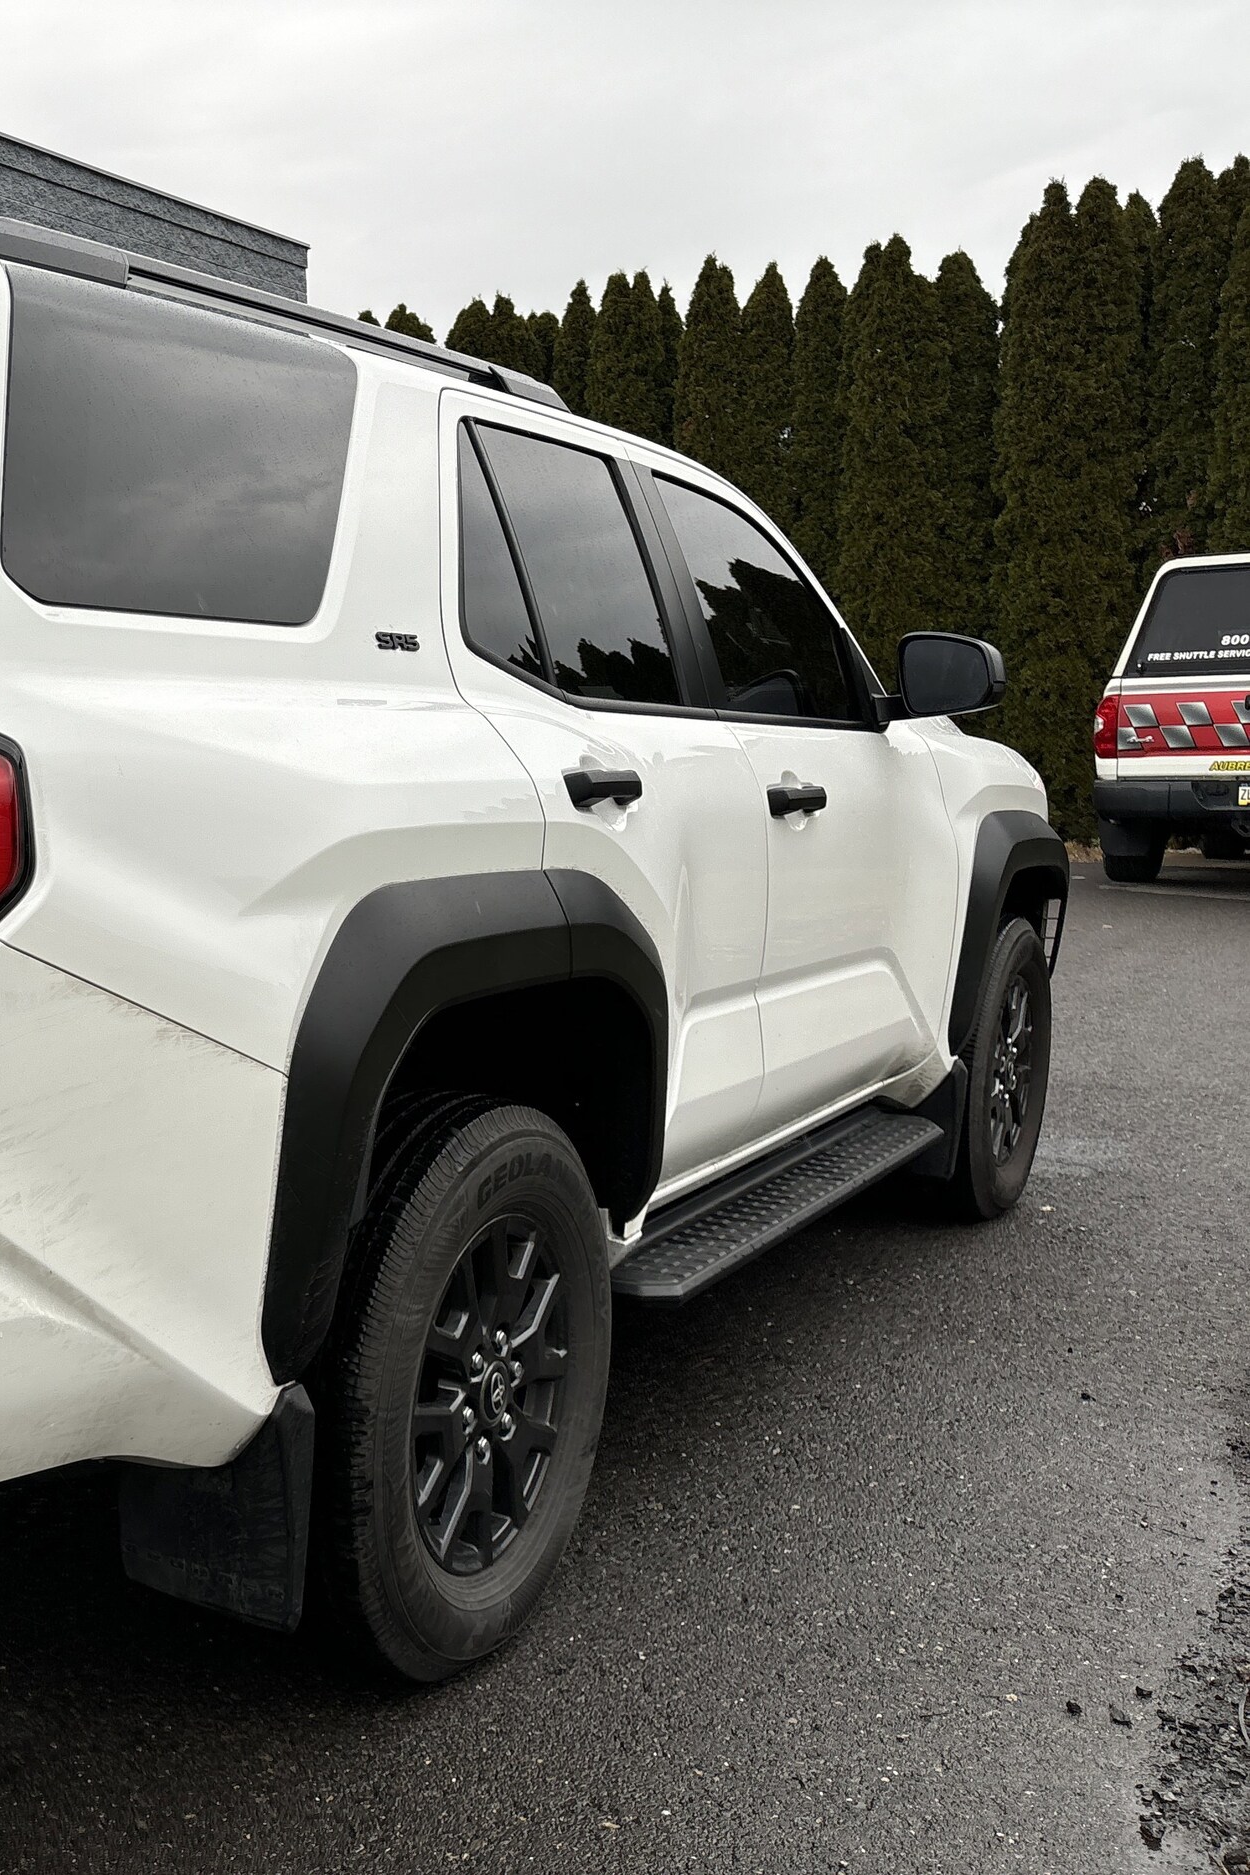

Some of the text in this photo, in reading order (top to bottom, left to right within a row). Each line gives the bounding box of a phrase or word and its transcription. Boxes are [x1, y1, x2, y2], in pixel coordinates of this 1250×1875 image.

[375, 631, 420, 652] SR5
[1220, 634, 1250, 646] 800
[1147, 652, 1171, 662] FREE
[1173, 650, 1216, 661] SHUTTLE
